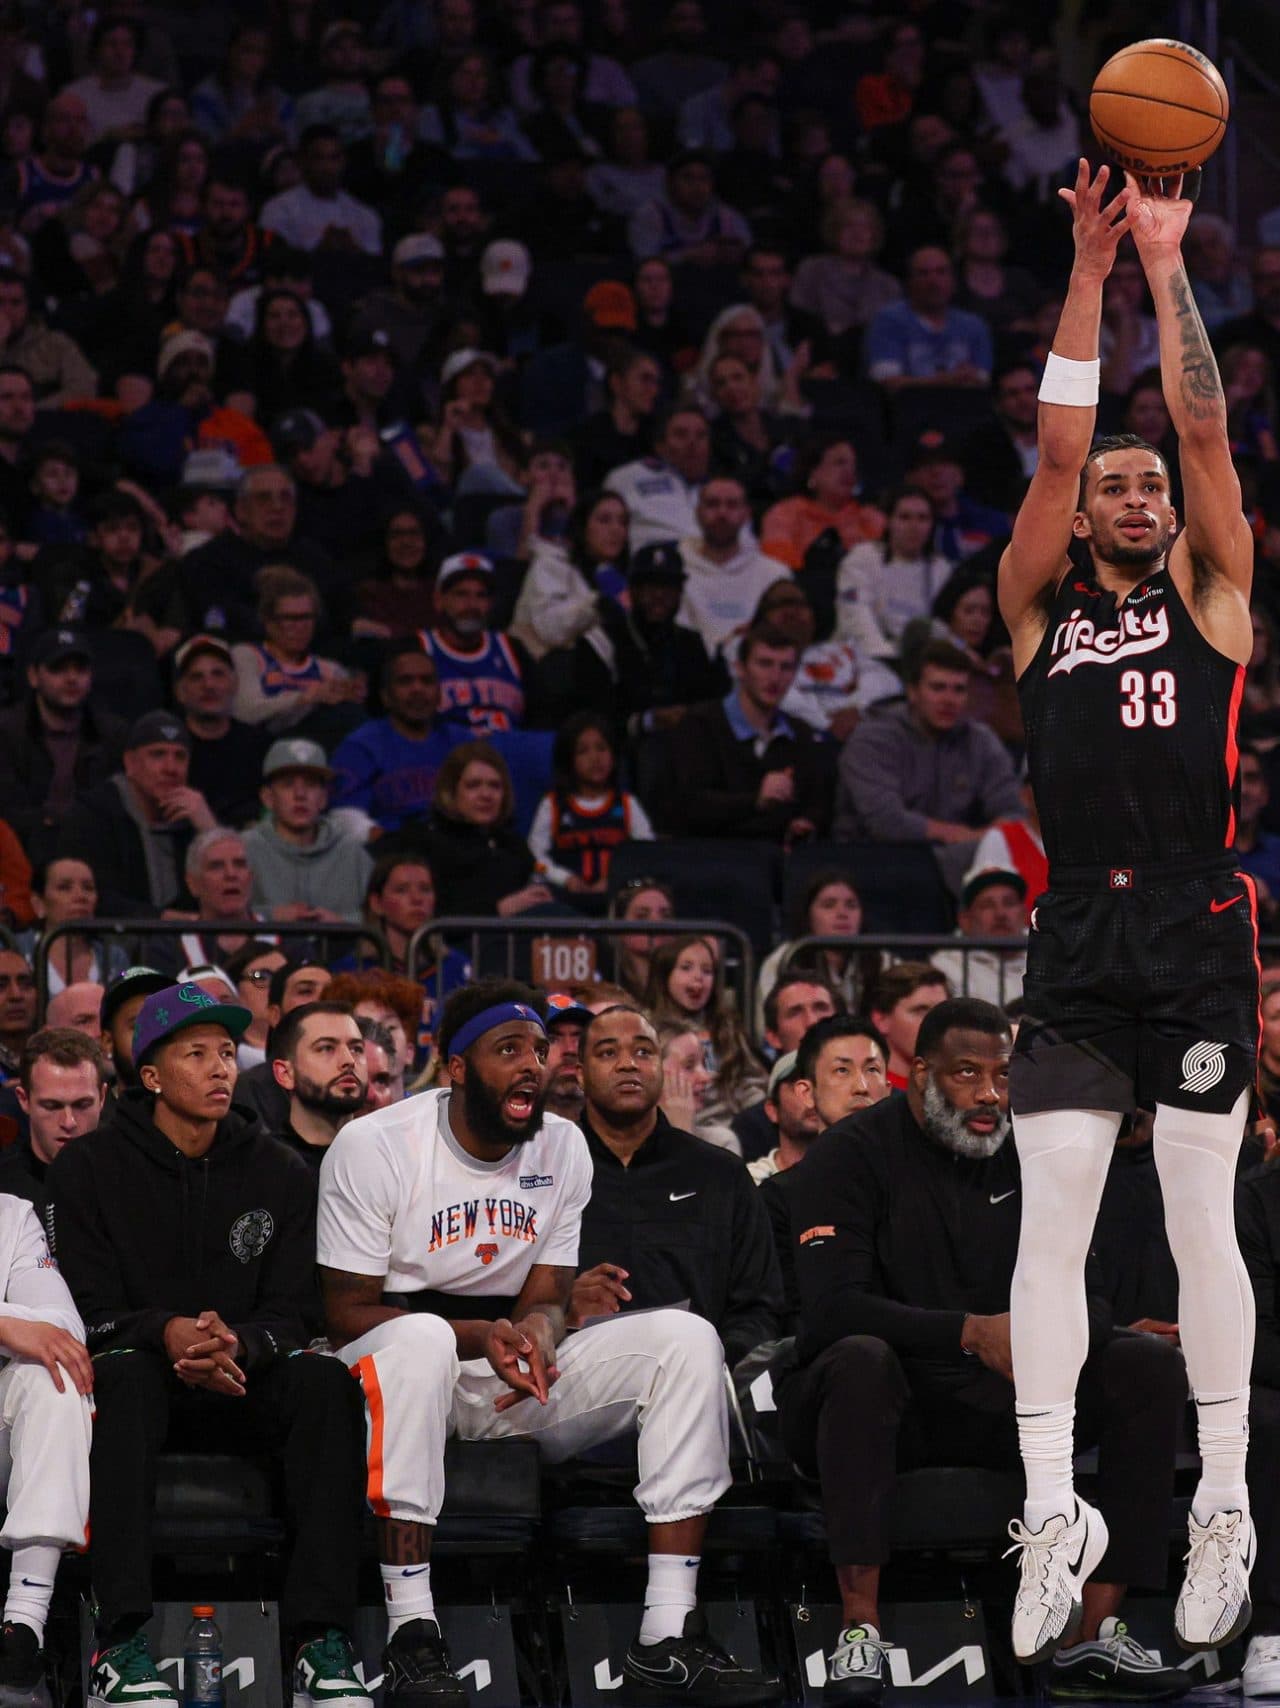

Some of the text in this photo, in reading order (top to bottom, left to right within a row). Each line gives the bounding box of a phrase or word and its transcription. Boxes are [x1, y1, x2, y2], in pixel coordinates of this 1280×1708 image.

[1120, 669, 1177, 728] 33
[540, 944, 589, 981] 108
[427, 1198, 538, 1253] NEW YORK
